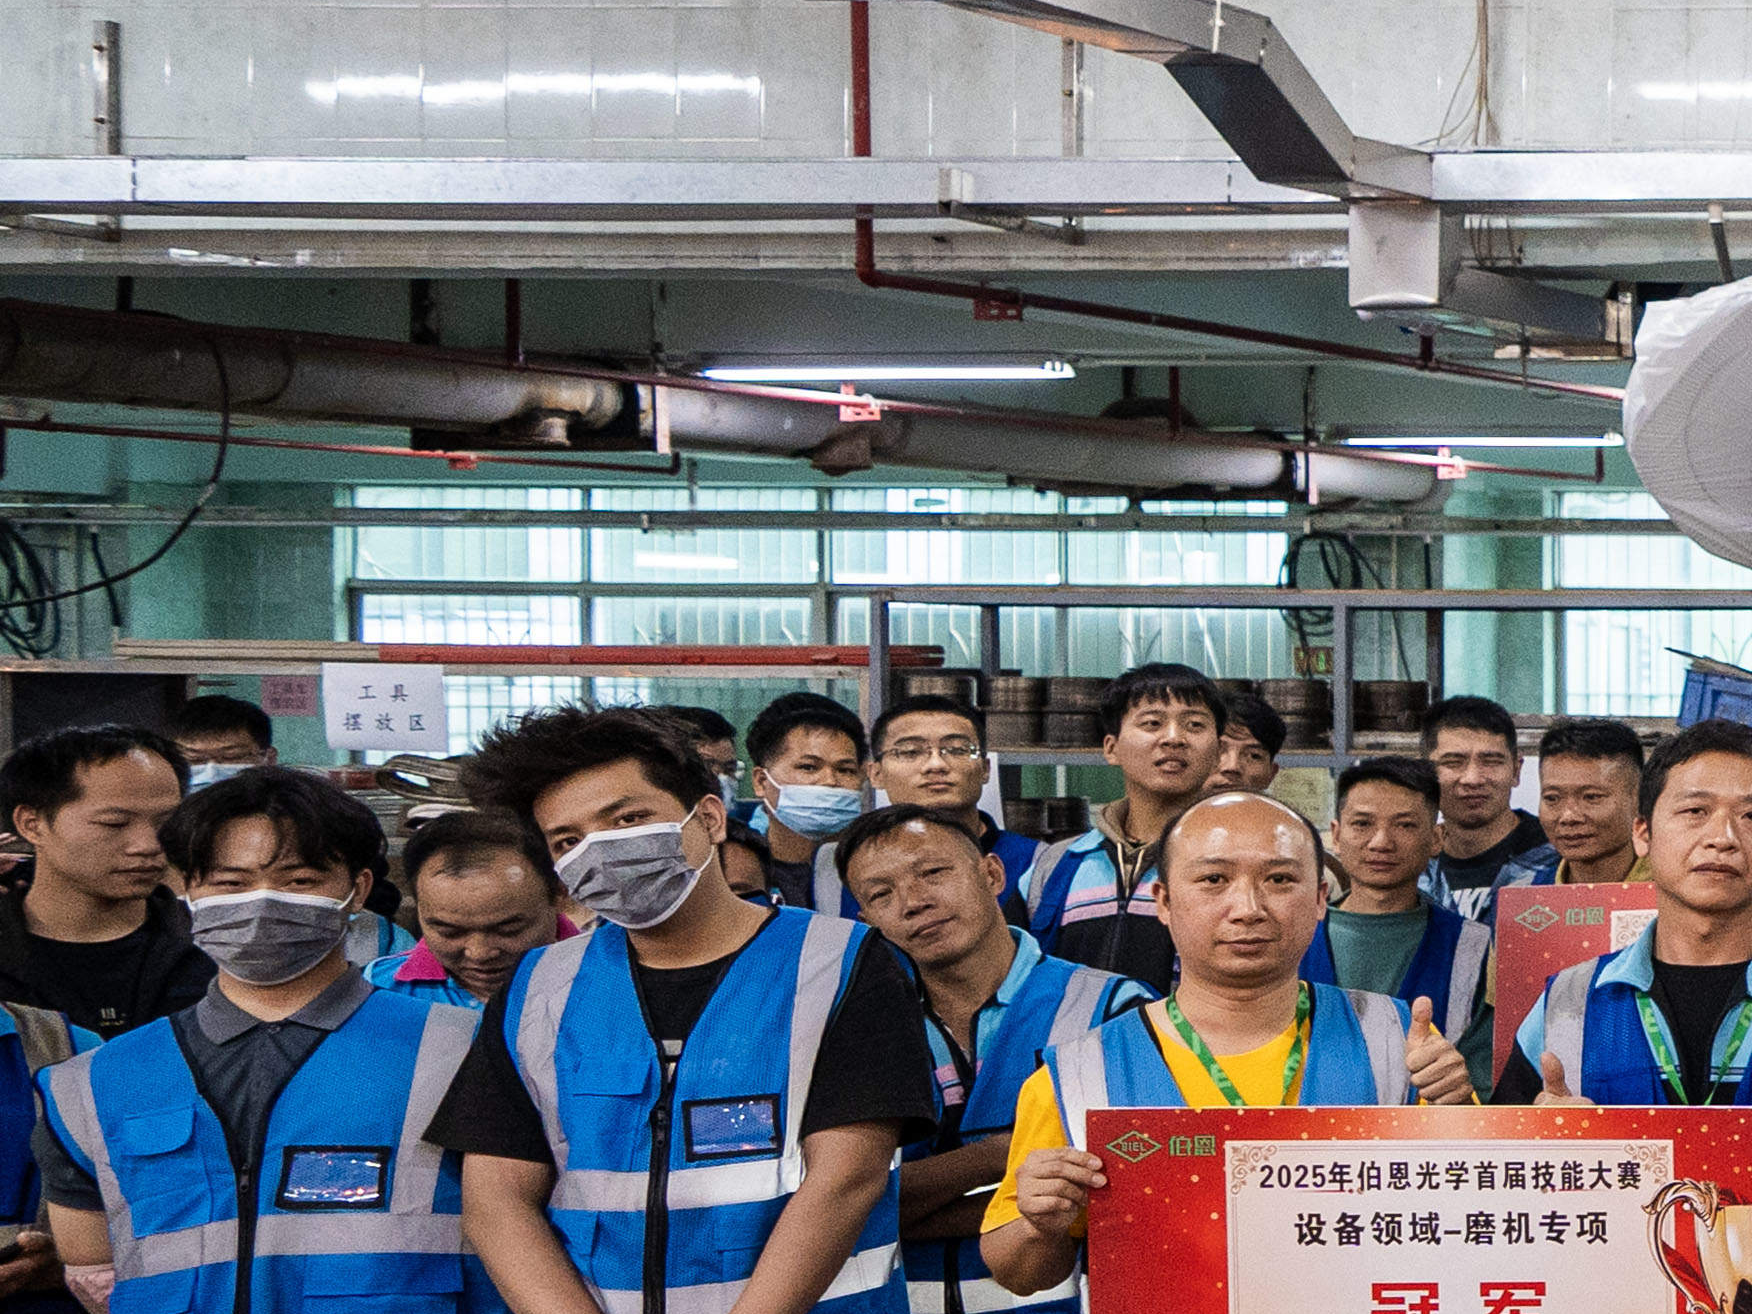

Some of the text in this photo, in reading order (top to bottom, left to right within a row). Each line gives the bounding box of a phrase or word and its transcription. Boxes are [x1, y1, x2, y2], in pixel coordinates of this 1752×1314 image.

[358, 684, 409, 702] 工具
[343, 712, 426, 732] 摆放区
[1565, 906, 1605, 926] 伯恩
[1120, 1140, 1148, 1152] BIEL
[1168, 1135, 1217, 1157] 伯恩
[1259, 1159, 1642, 1192] 2025年伯恩光学首届技能大赛
[1294, 1210, 1610, 1247] 设备领域-磨机专项
